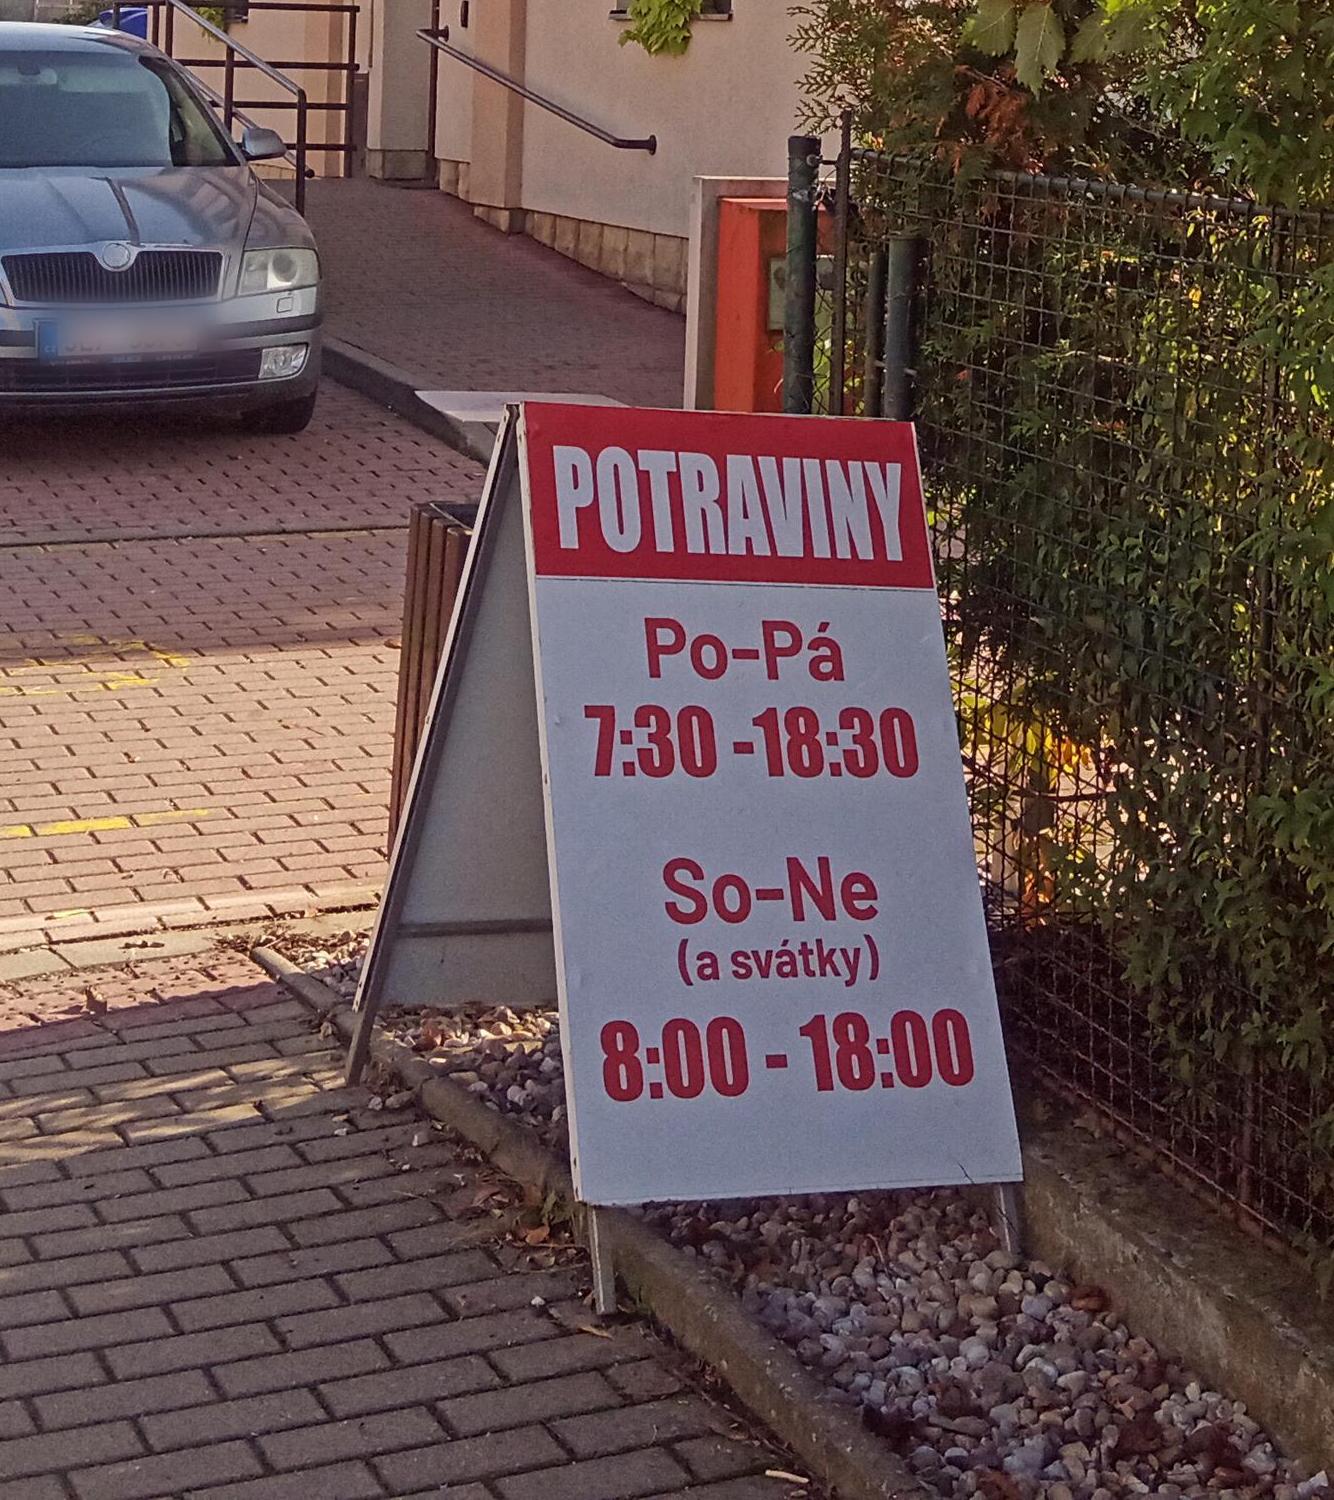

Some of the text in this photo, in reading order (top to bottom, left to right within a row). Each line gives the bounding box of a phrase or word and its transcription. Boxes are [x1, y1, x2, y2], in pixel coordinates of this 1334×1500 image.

[552, 445, 902, 561] POTRAVINY
[644, 617, 845, 681] Po-Pá
[584, 704, 717, 777] 7:30
[662, 857, 879, 925] So-Ne
[677, 934, 880, 987] (a svátky)
[600, 1016, 749, 1102] 8:00
[799, 1008, 975, 1092] 18:00
